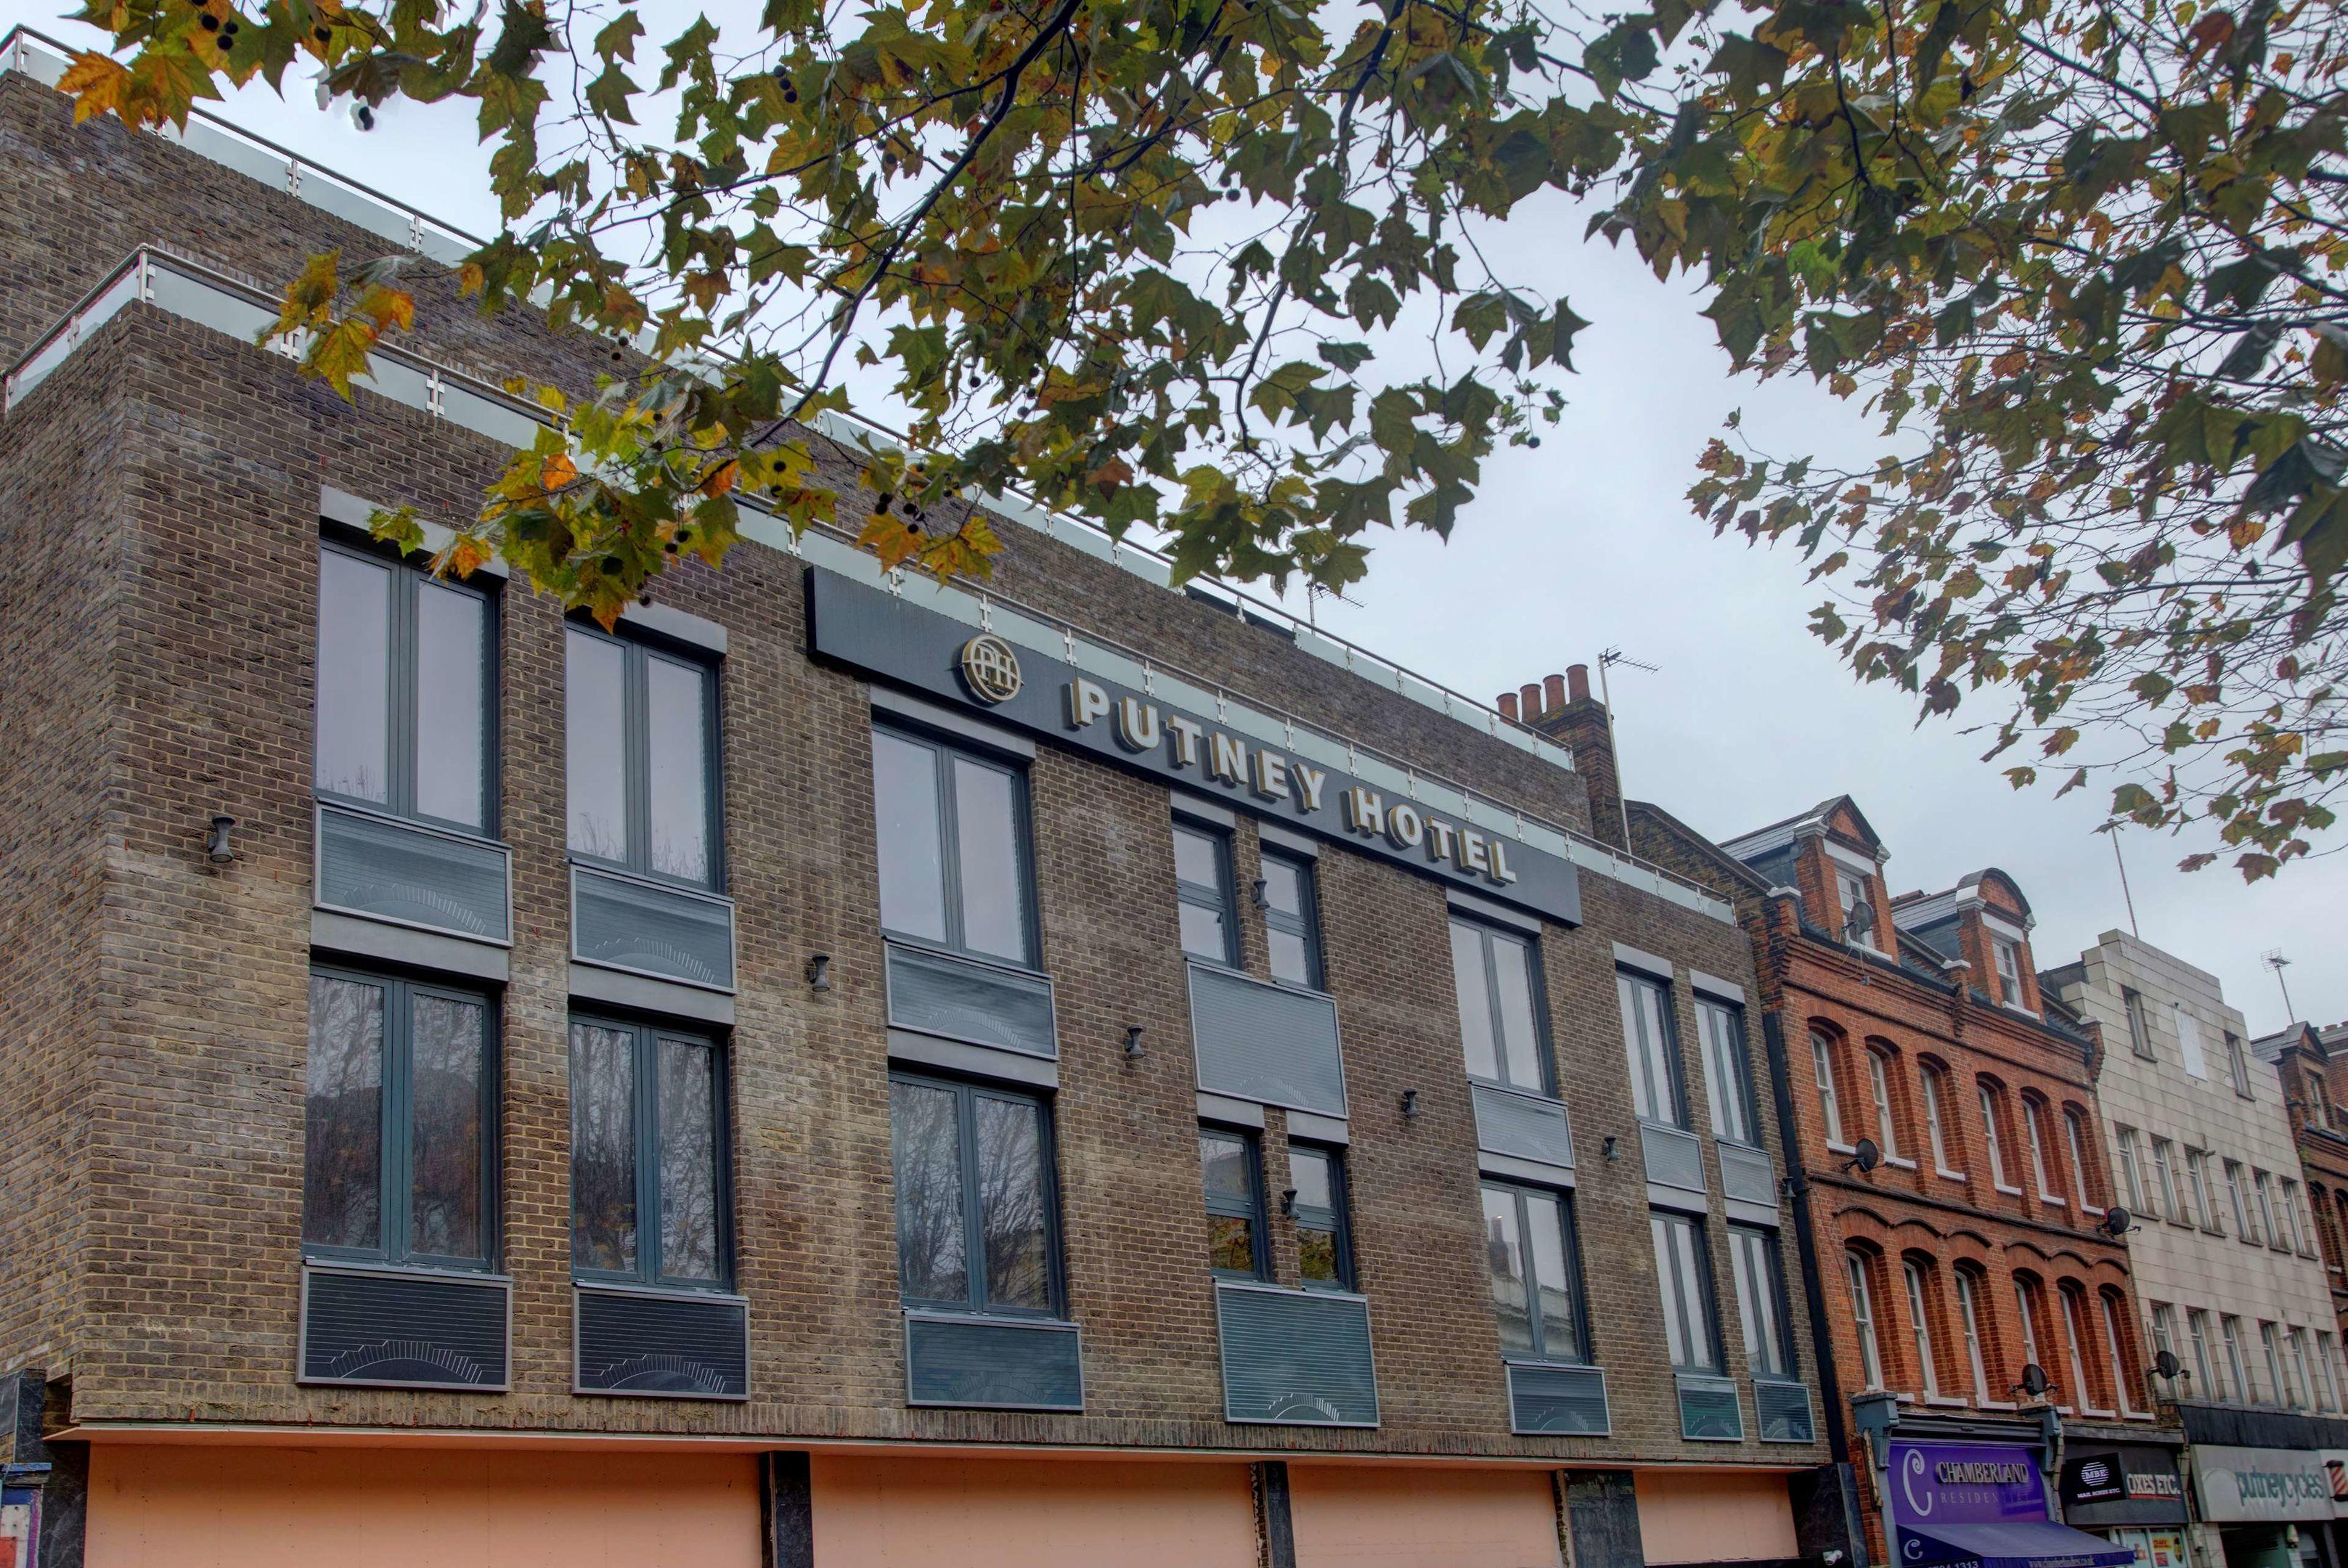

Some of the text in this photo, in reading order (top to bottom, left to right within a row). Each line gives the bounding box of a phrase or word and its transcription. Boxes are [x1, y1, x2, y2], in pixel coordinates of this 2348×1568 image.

[1069, 676, 1517, 886] PUTNEY HOTEL
[1936, 1461, 2029, 1483] CHAMBERLAND
[2084, 1470, 2106, 1479] MBE
[2126, 1474, 2180, 1494] OXES ETC.
